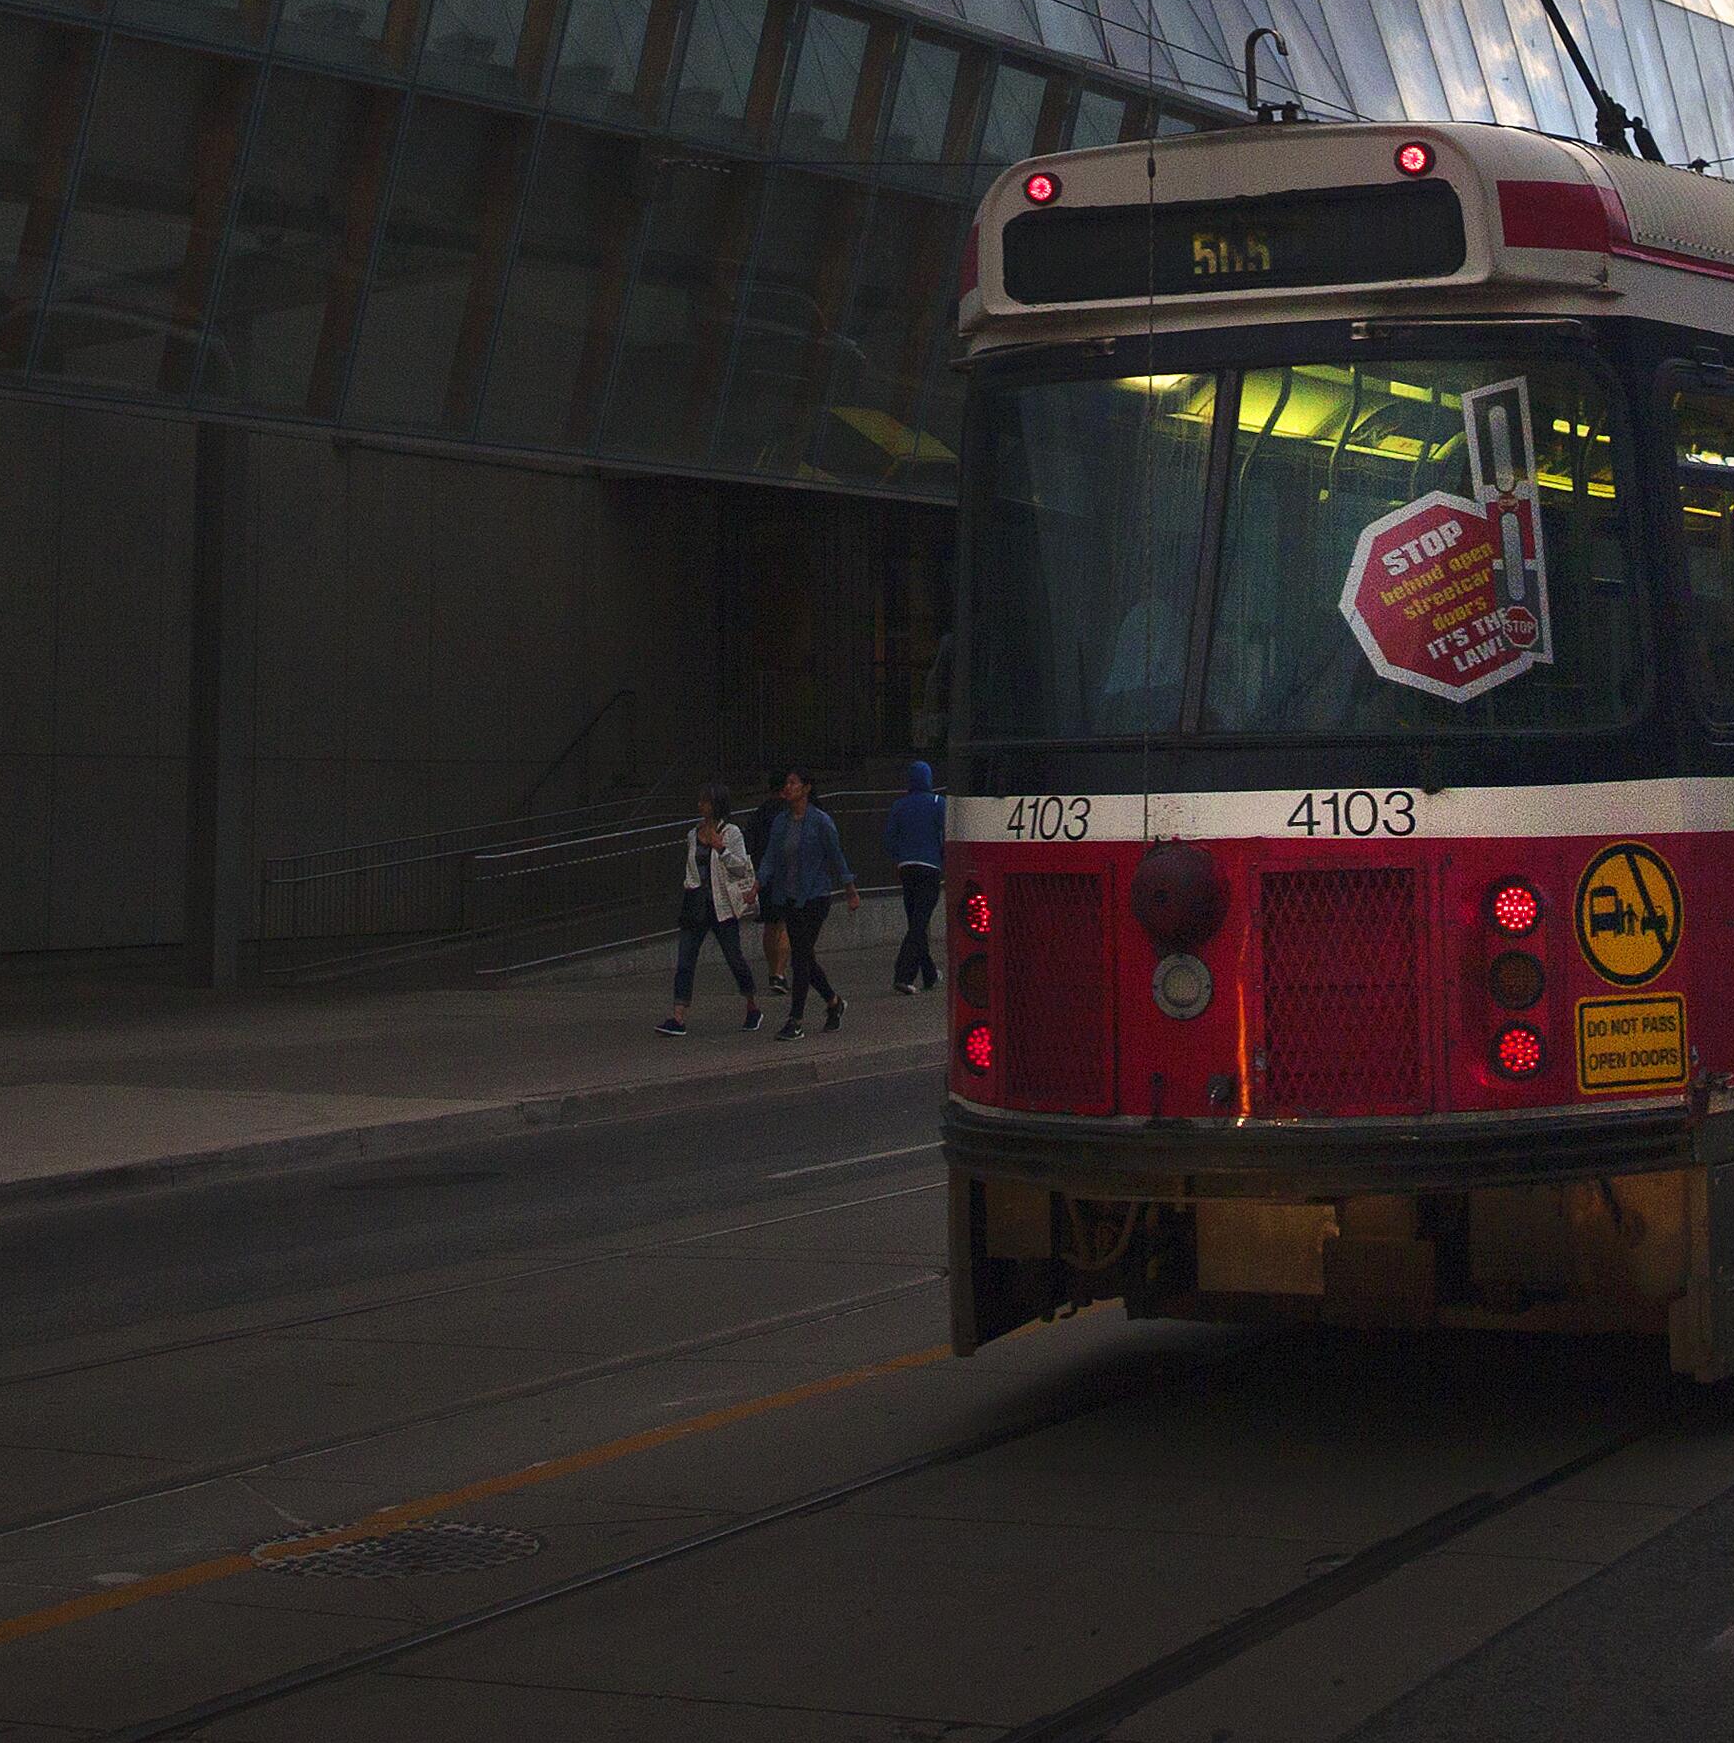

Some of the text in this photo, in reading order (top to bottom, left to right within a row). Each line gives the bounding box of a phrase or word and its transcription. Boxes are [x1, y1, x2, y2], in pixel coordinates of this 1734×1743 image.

[1382, 520, 1463, 576] STOP
[1379, 542, 1496, 607] behind open
[1403, 567, 1490, 620] streetcar
[1432, 596, 1488, 632] doors
[1505, 619, 1535, 634] STOP
[1427, 627, 1469, 660] IT'S
[1006, 796, 1092, 841] 4103
[1286, 790, 1417, 837] 4103
[1587, 1014, 1677, 1037] DO NOT PASS
[1587, 1048, 1678, 1071] OPEN DOORS
